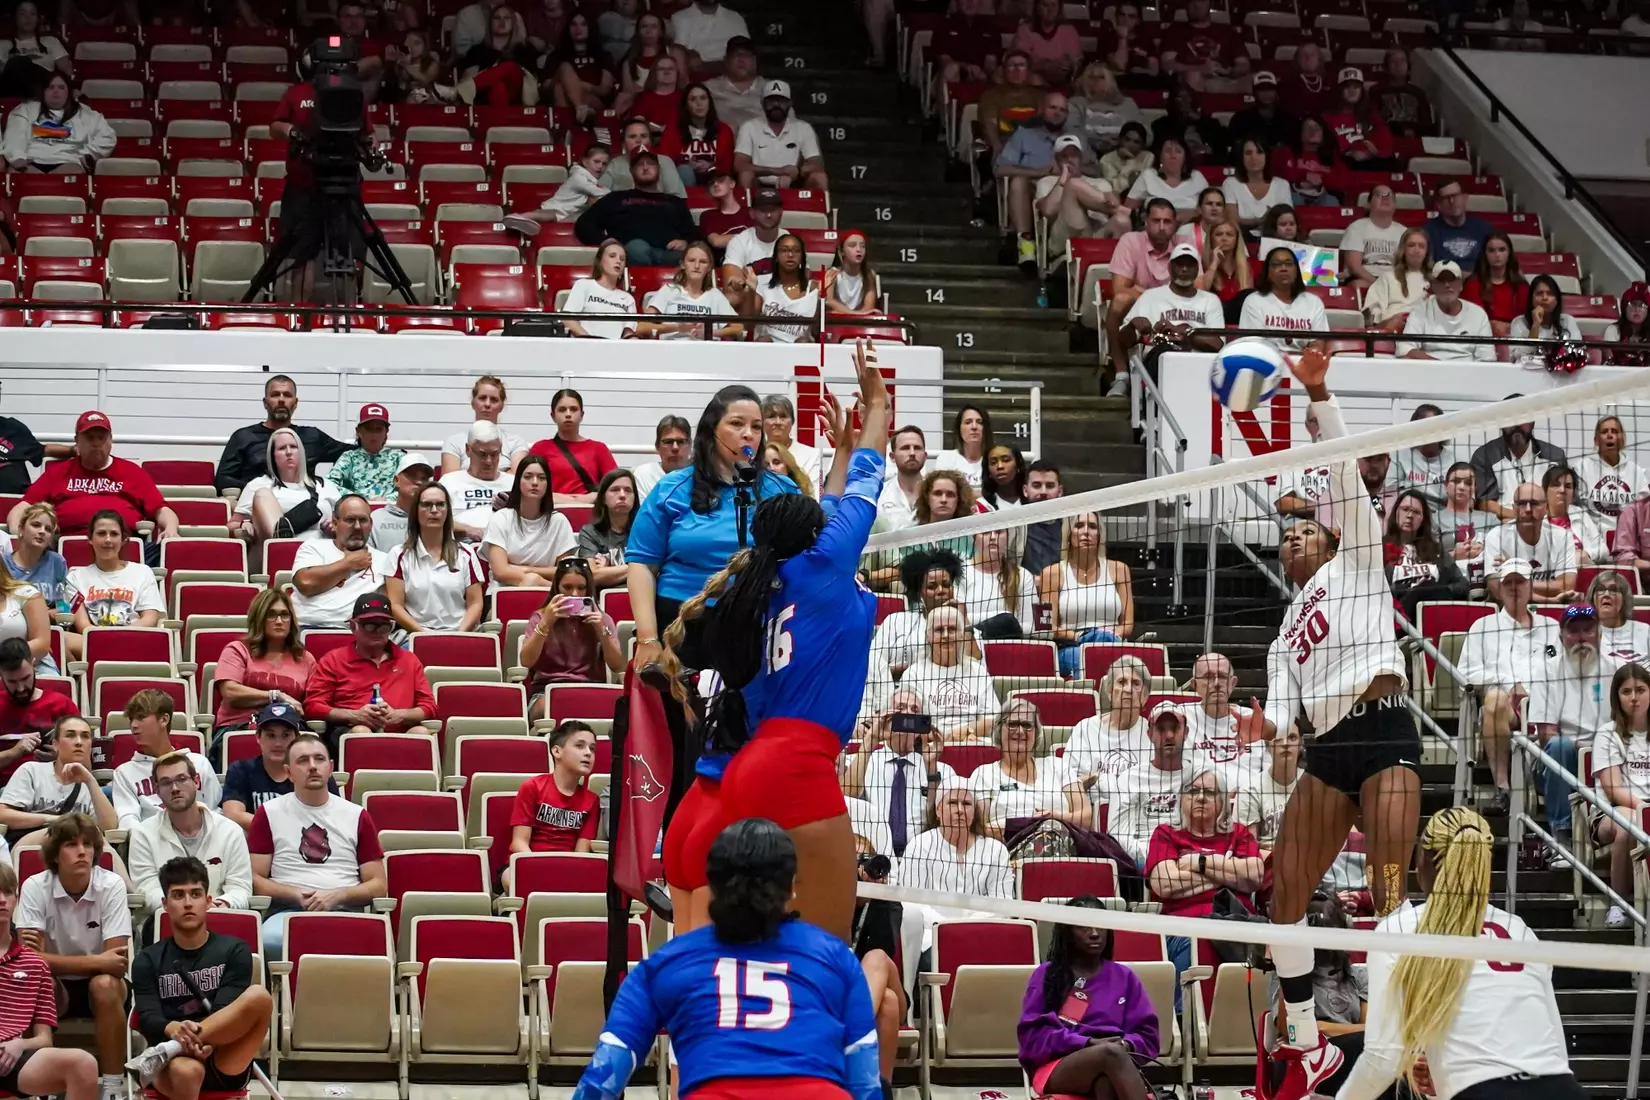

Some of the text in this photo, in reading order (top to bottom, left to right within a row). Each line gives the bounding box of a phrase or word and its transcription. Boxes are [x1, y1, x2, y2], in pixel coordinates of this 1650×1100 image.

[767, 23, 783, 36] 21
[785, 56, 805, 69] 20
[772, 82, 782, 92] A
[811, 92, 828, 105] 19
[829, 127, 846, 140] 18
[850, 165, 868, 179] 17
[875, 207, 893, 221] 16
[900, 248, 918, 262] 15
[925, 288, 945, 303] 14
[956, 332, 974, 347] 13
[1013, 422, 1028, 438] 11
[67, 477, 124, 492] ARKANSAS
[464, 489, 493, 498] CBU
[1283, 587, 1327, 642] RKANSAS
[766, 603, 797, 677] 16
[1289, 609, 1330, 665] 30
[1378, 694, 1407, 711] NIK
[713, 957, 791, 1030] 15
